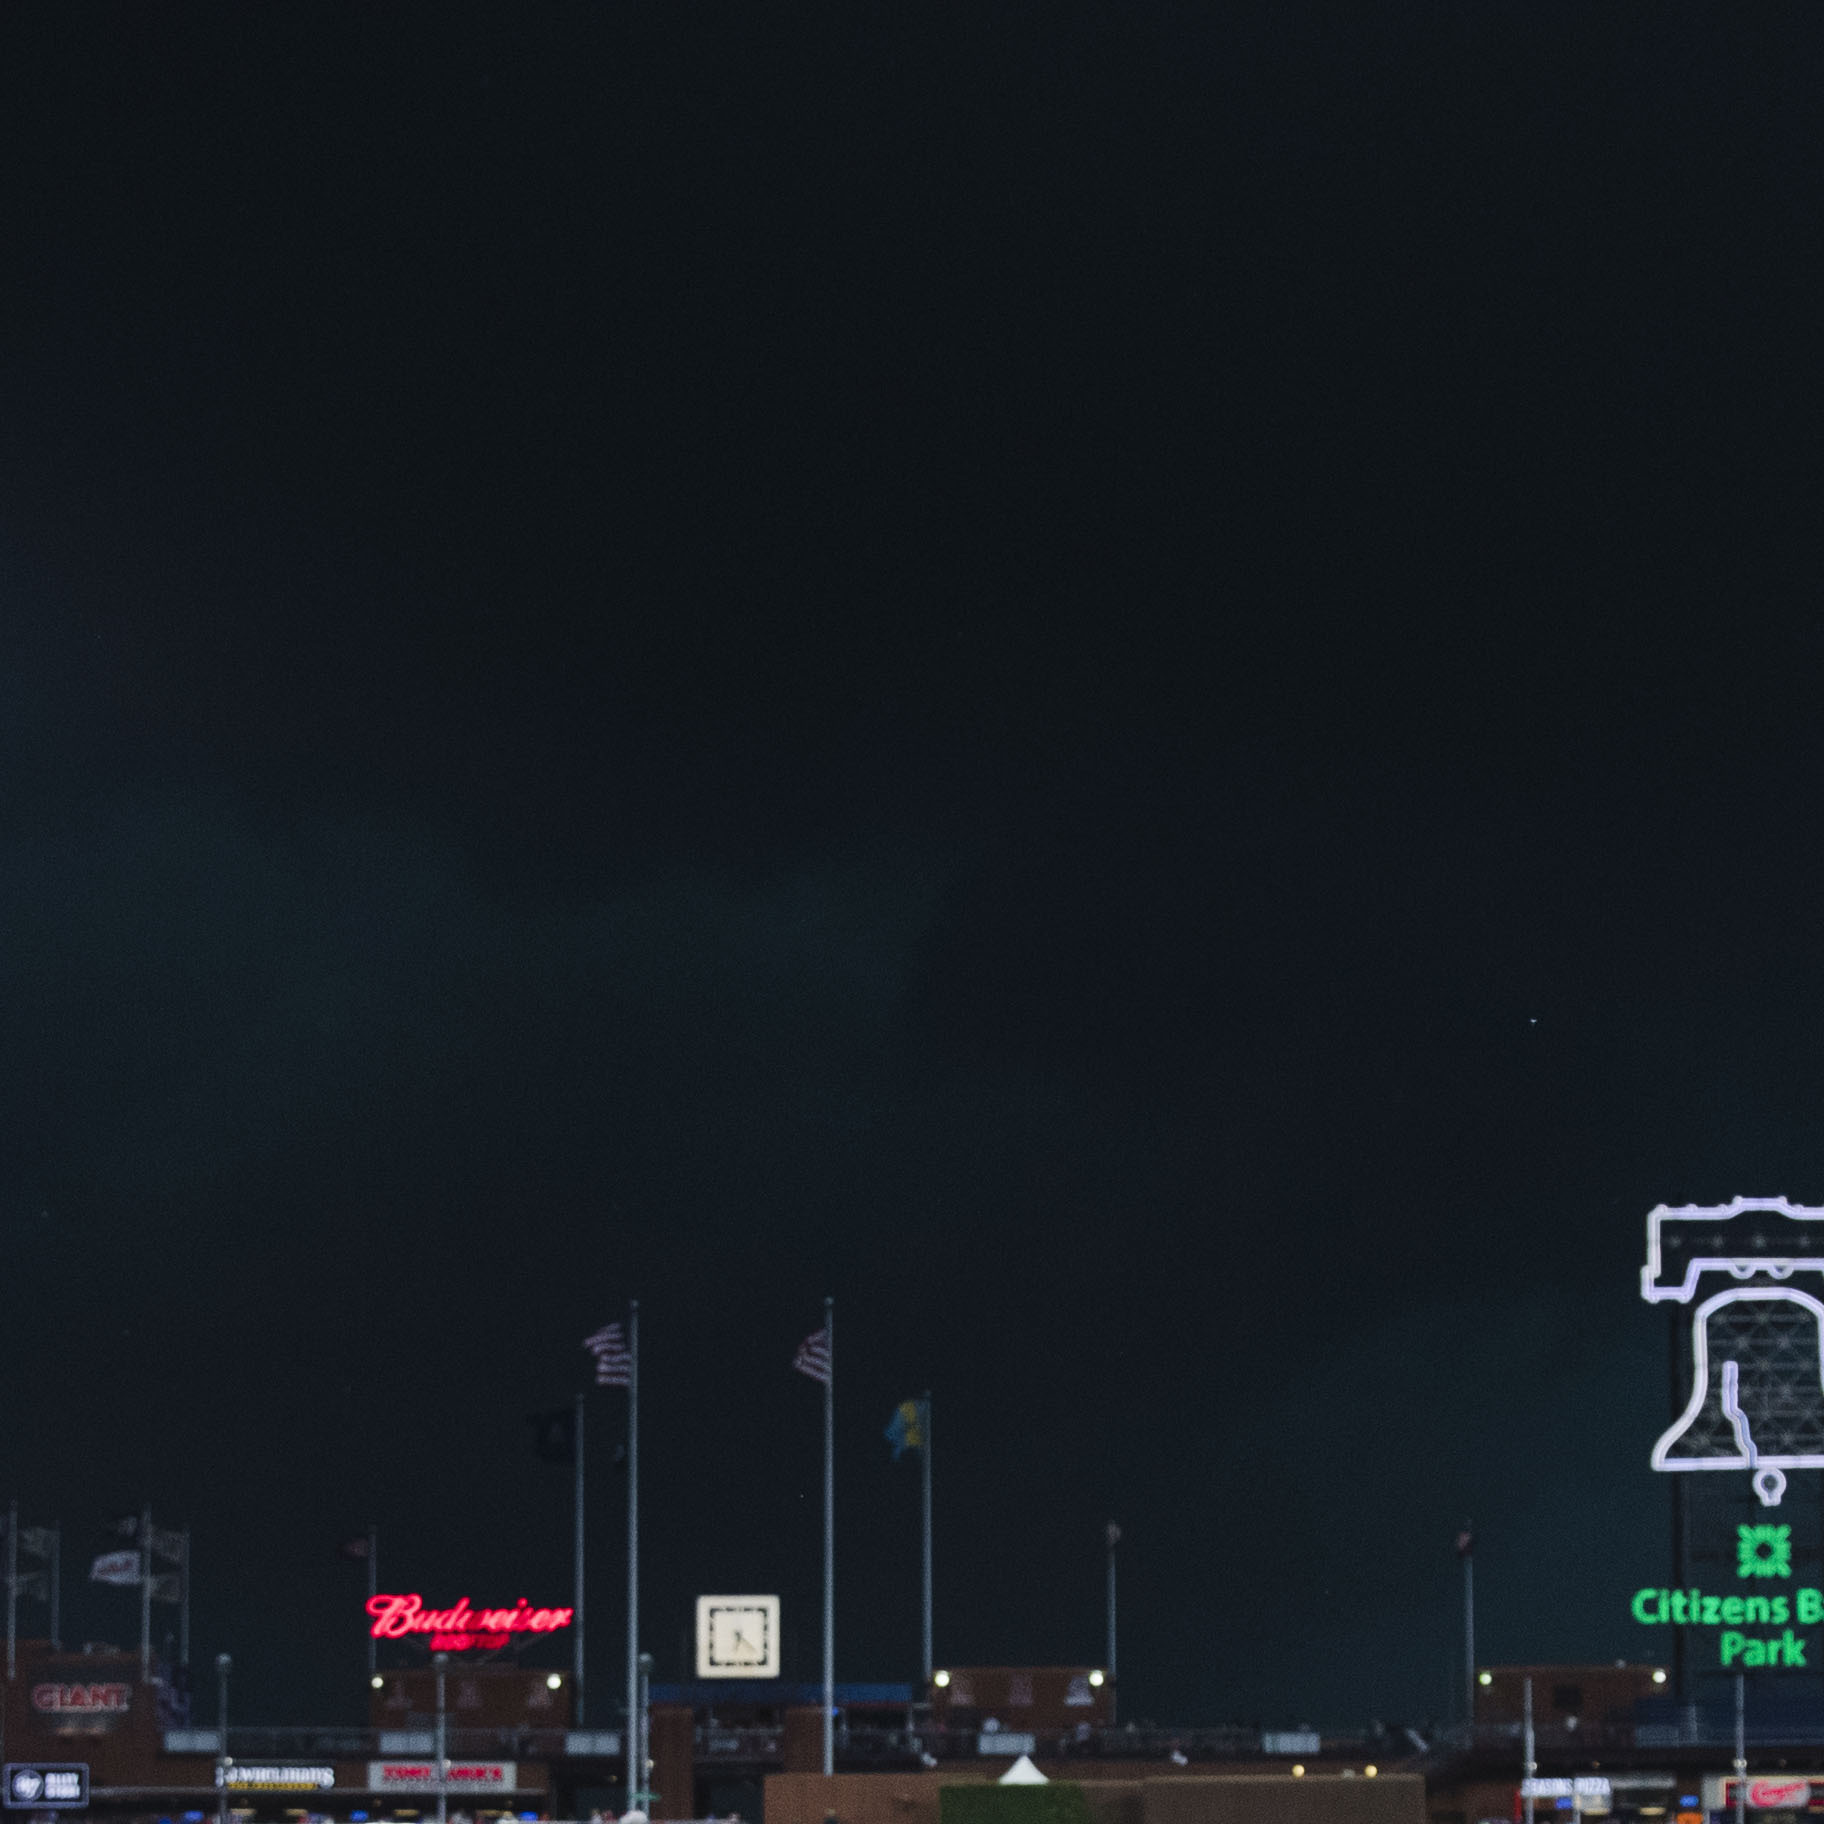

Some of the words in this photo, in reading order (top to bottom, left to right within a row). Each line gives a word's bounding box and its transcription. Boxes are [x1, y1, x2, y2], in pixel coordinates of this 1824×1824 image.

[365, 1593, 574, 1639] Budweiser
[1631, 1588, 1791, 1625] Citizens
[1720, 1630, 1808, 1667] Park
